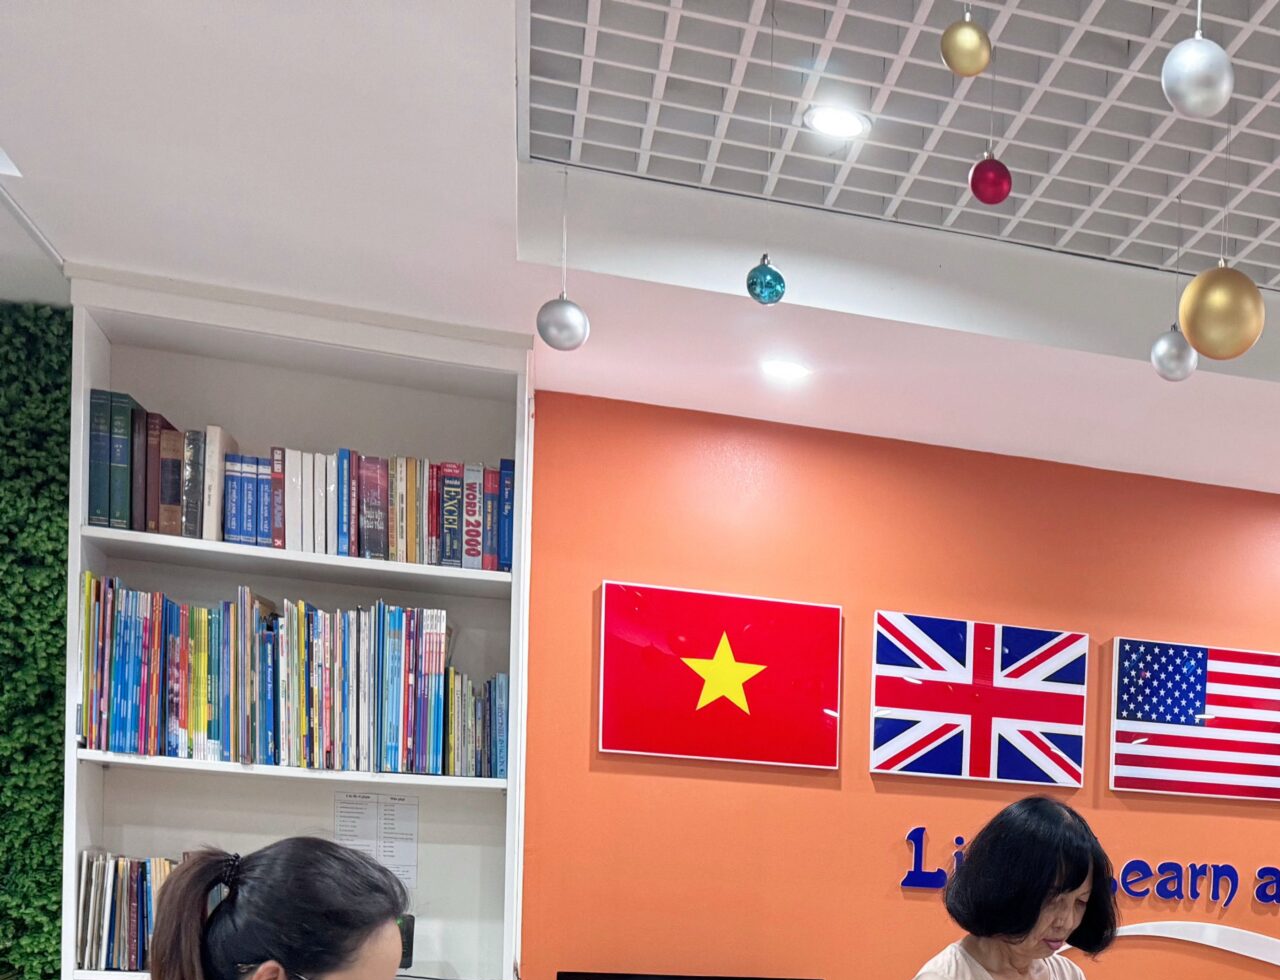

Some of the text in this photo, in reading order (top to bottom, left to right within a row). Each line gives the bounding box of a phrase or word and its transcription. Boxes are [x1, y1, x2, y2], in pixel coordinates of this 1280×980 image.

[444, 487, 462, 533] EXCEL
[464, 482, 482, 557] WORD 2000
[1111, 858, 1240, 908] earn
